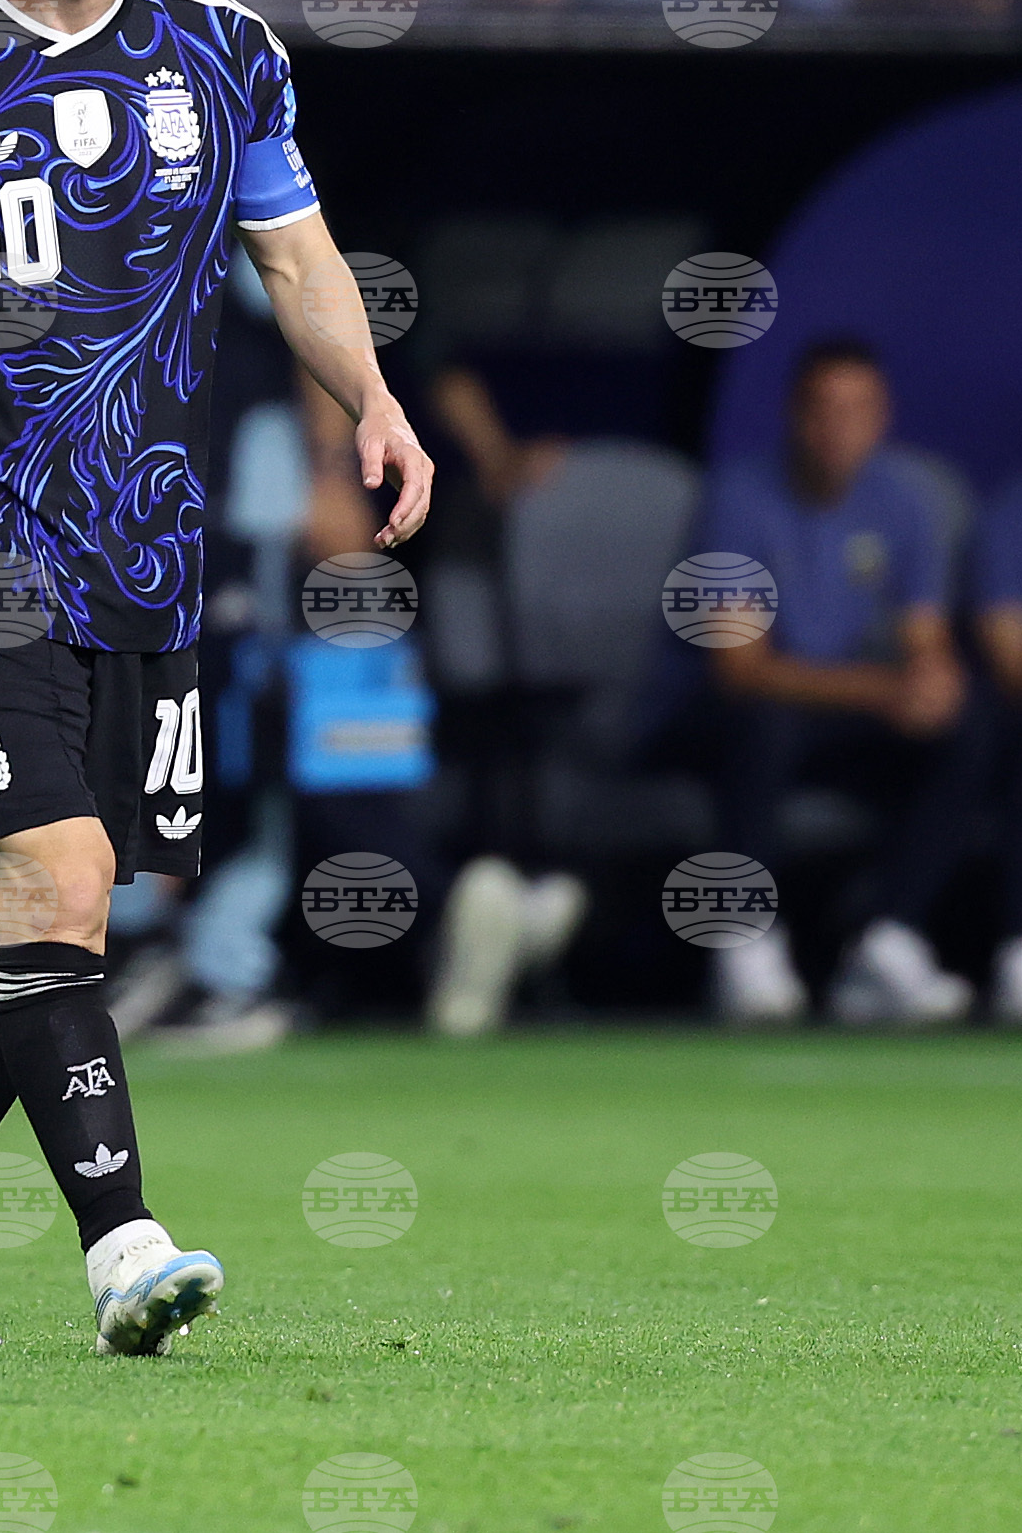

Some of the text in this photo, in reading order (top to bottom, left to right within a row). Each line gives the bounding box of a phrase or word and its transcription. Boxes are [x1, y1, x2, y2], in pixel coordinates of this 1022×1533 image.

[160, 109, 188, 138] AFA
[73, 137, 97, 148] FIFA
[144, 687, 204, 794] 10
[62, 1056, 116, 1101] AFA
